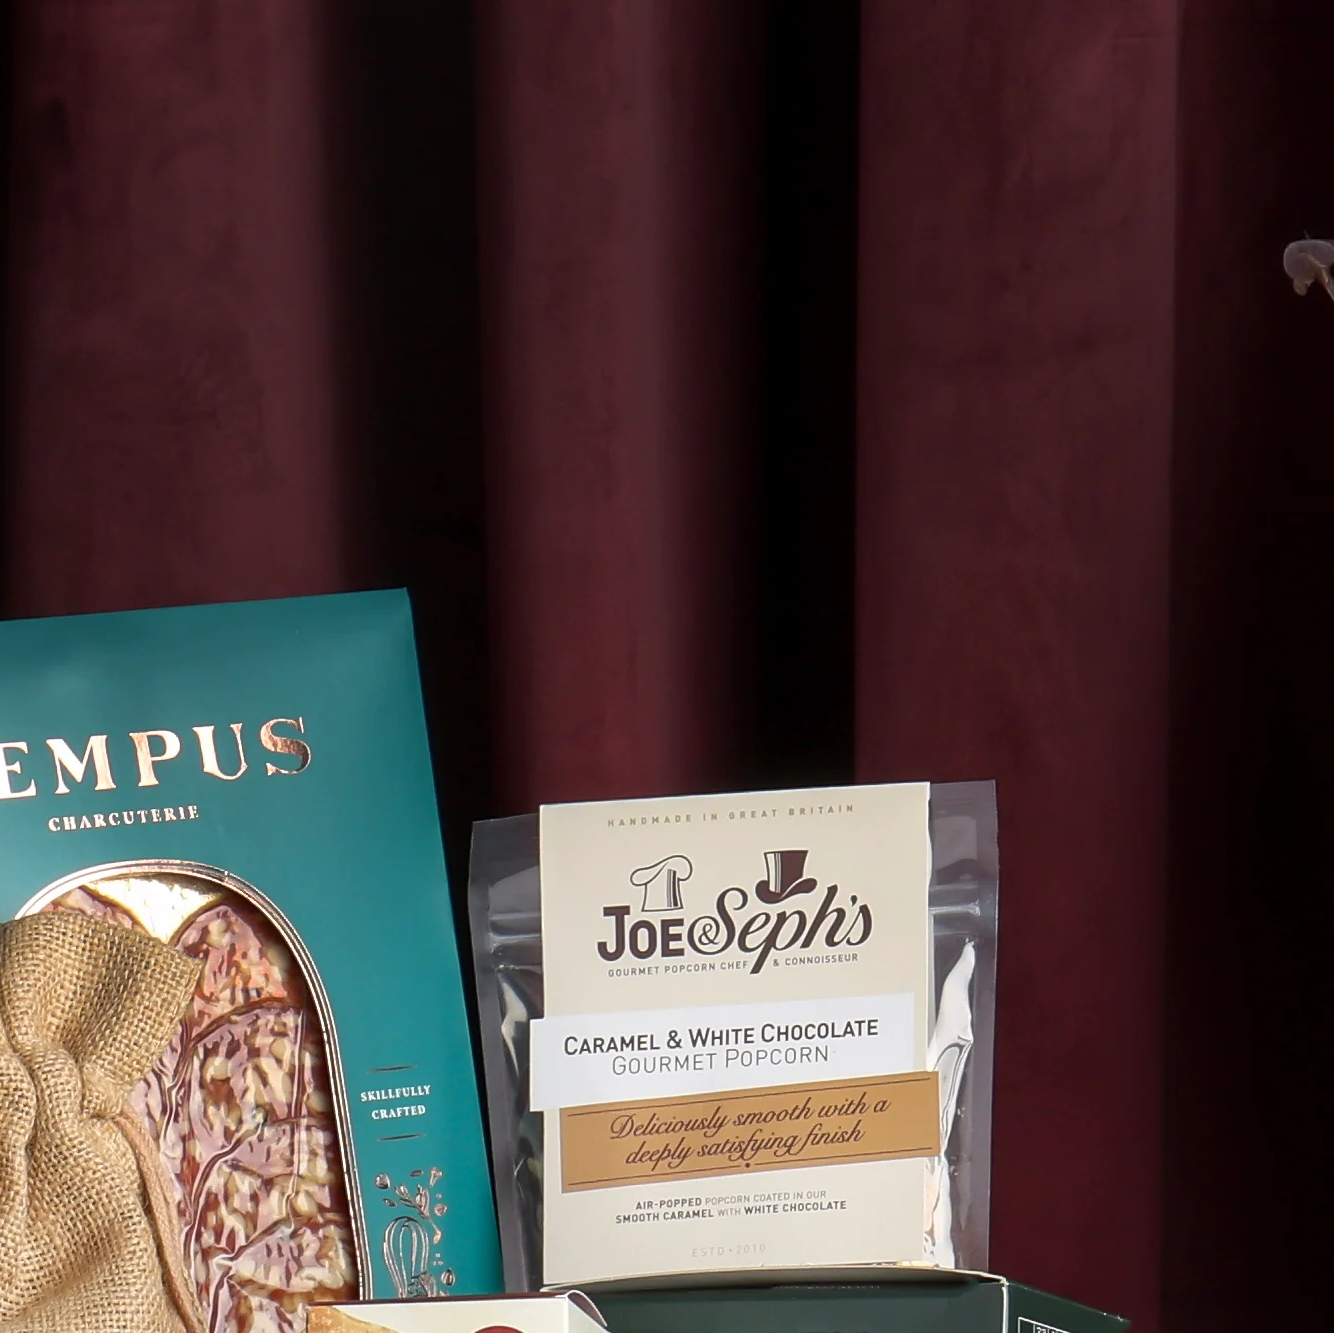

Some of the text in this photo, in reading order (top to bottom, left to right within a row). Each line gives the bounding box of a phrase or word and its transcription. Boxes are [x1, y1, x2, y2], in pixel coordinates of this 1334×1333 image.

[48, 806, 199, 832] CHARCUTERIE
[607, 805, 854, 827] HANDMADE IN GREAT BRITAIN
[564, 1018, 879, 1055] CARAMEL & WHITE CHOCOLATE
[612, 1045, 830, 1076] GOURMET POPCORN
[361, 1084, 431, 1102] SKILLFULLY
[371, 1104, 426, 1120] CRAFTED
[610, 1097, 890, 1140] Deliciously smooth with a
[626, 1123, 864, 1171] deeply satisfying finish
